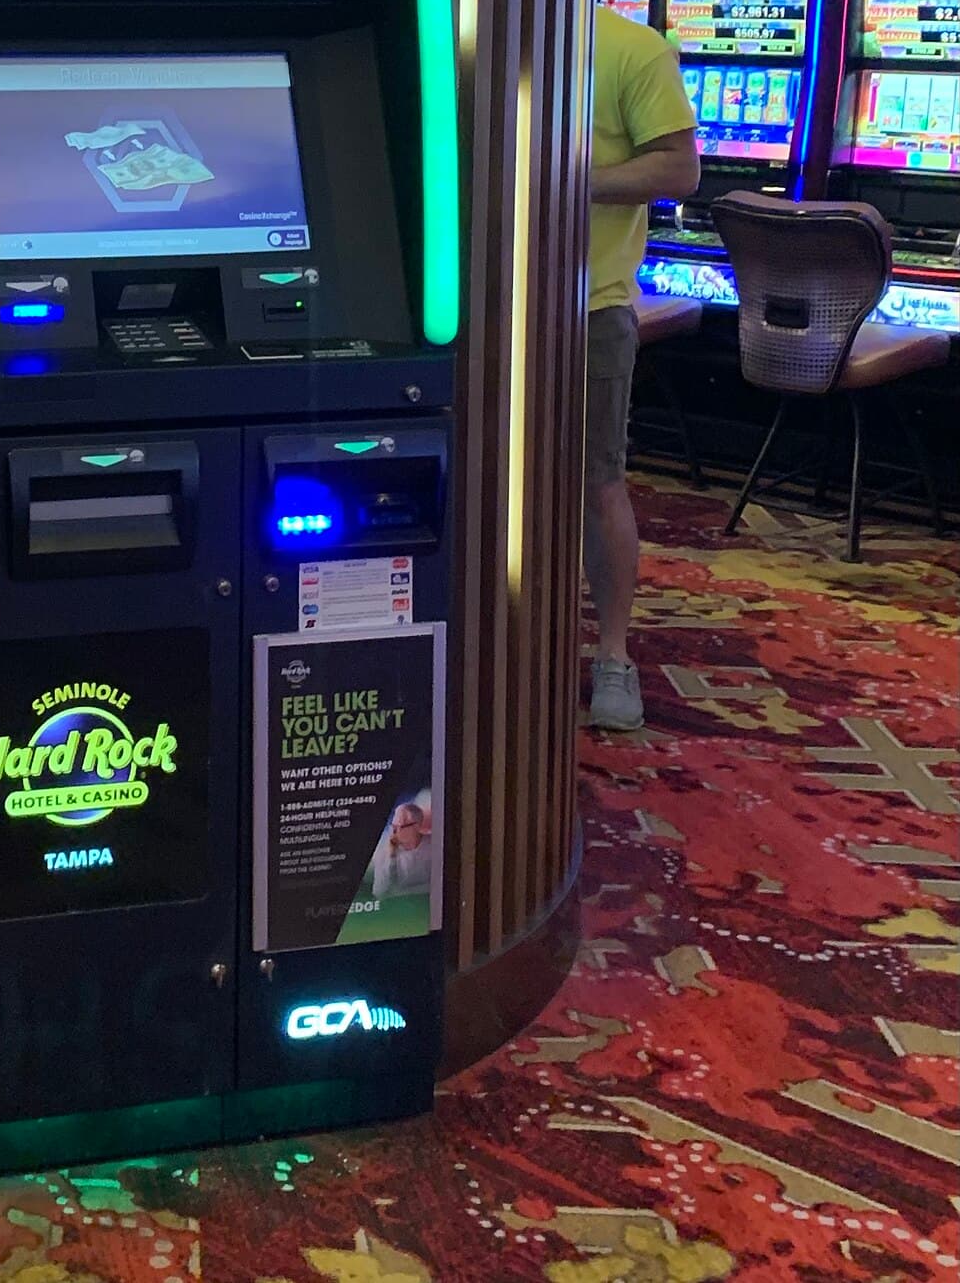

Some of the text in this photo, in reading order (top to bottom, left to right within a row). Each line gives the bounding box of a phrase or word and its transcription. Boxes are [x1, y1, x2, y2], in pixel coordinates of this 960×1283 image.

[32, 682, 132, 716] SEMINOLE
[282, 690, 379, 716] FEEL LIKE
[281, 709, 405, 737] YOU CAN'T
[82, 723, 178, 779] Rock
[281, 733, 359, 758] LEAVE?
[281, 760, 393, 778] WANT OTHER OPTIONS?
[281, 774, 383, 792] WE ARE HERE TO HELP
[11, 787, 143, 810] HOTEL & CASINO
[44, 847, 114, 870] TAMPA
[287, 999, 373, 1040] GCA
